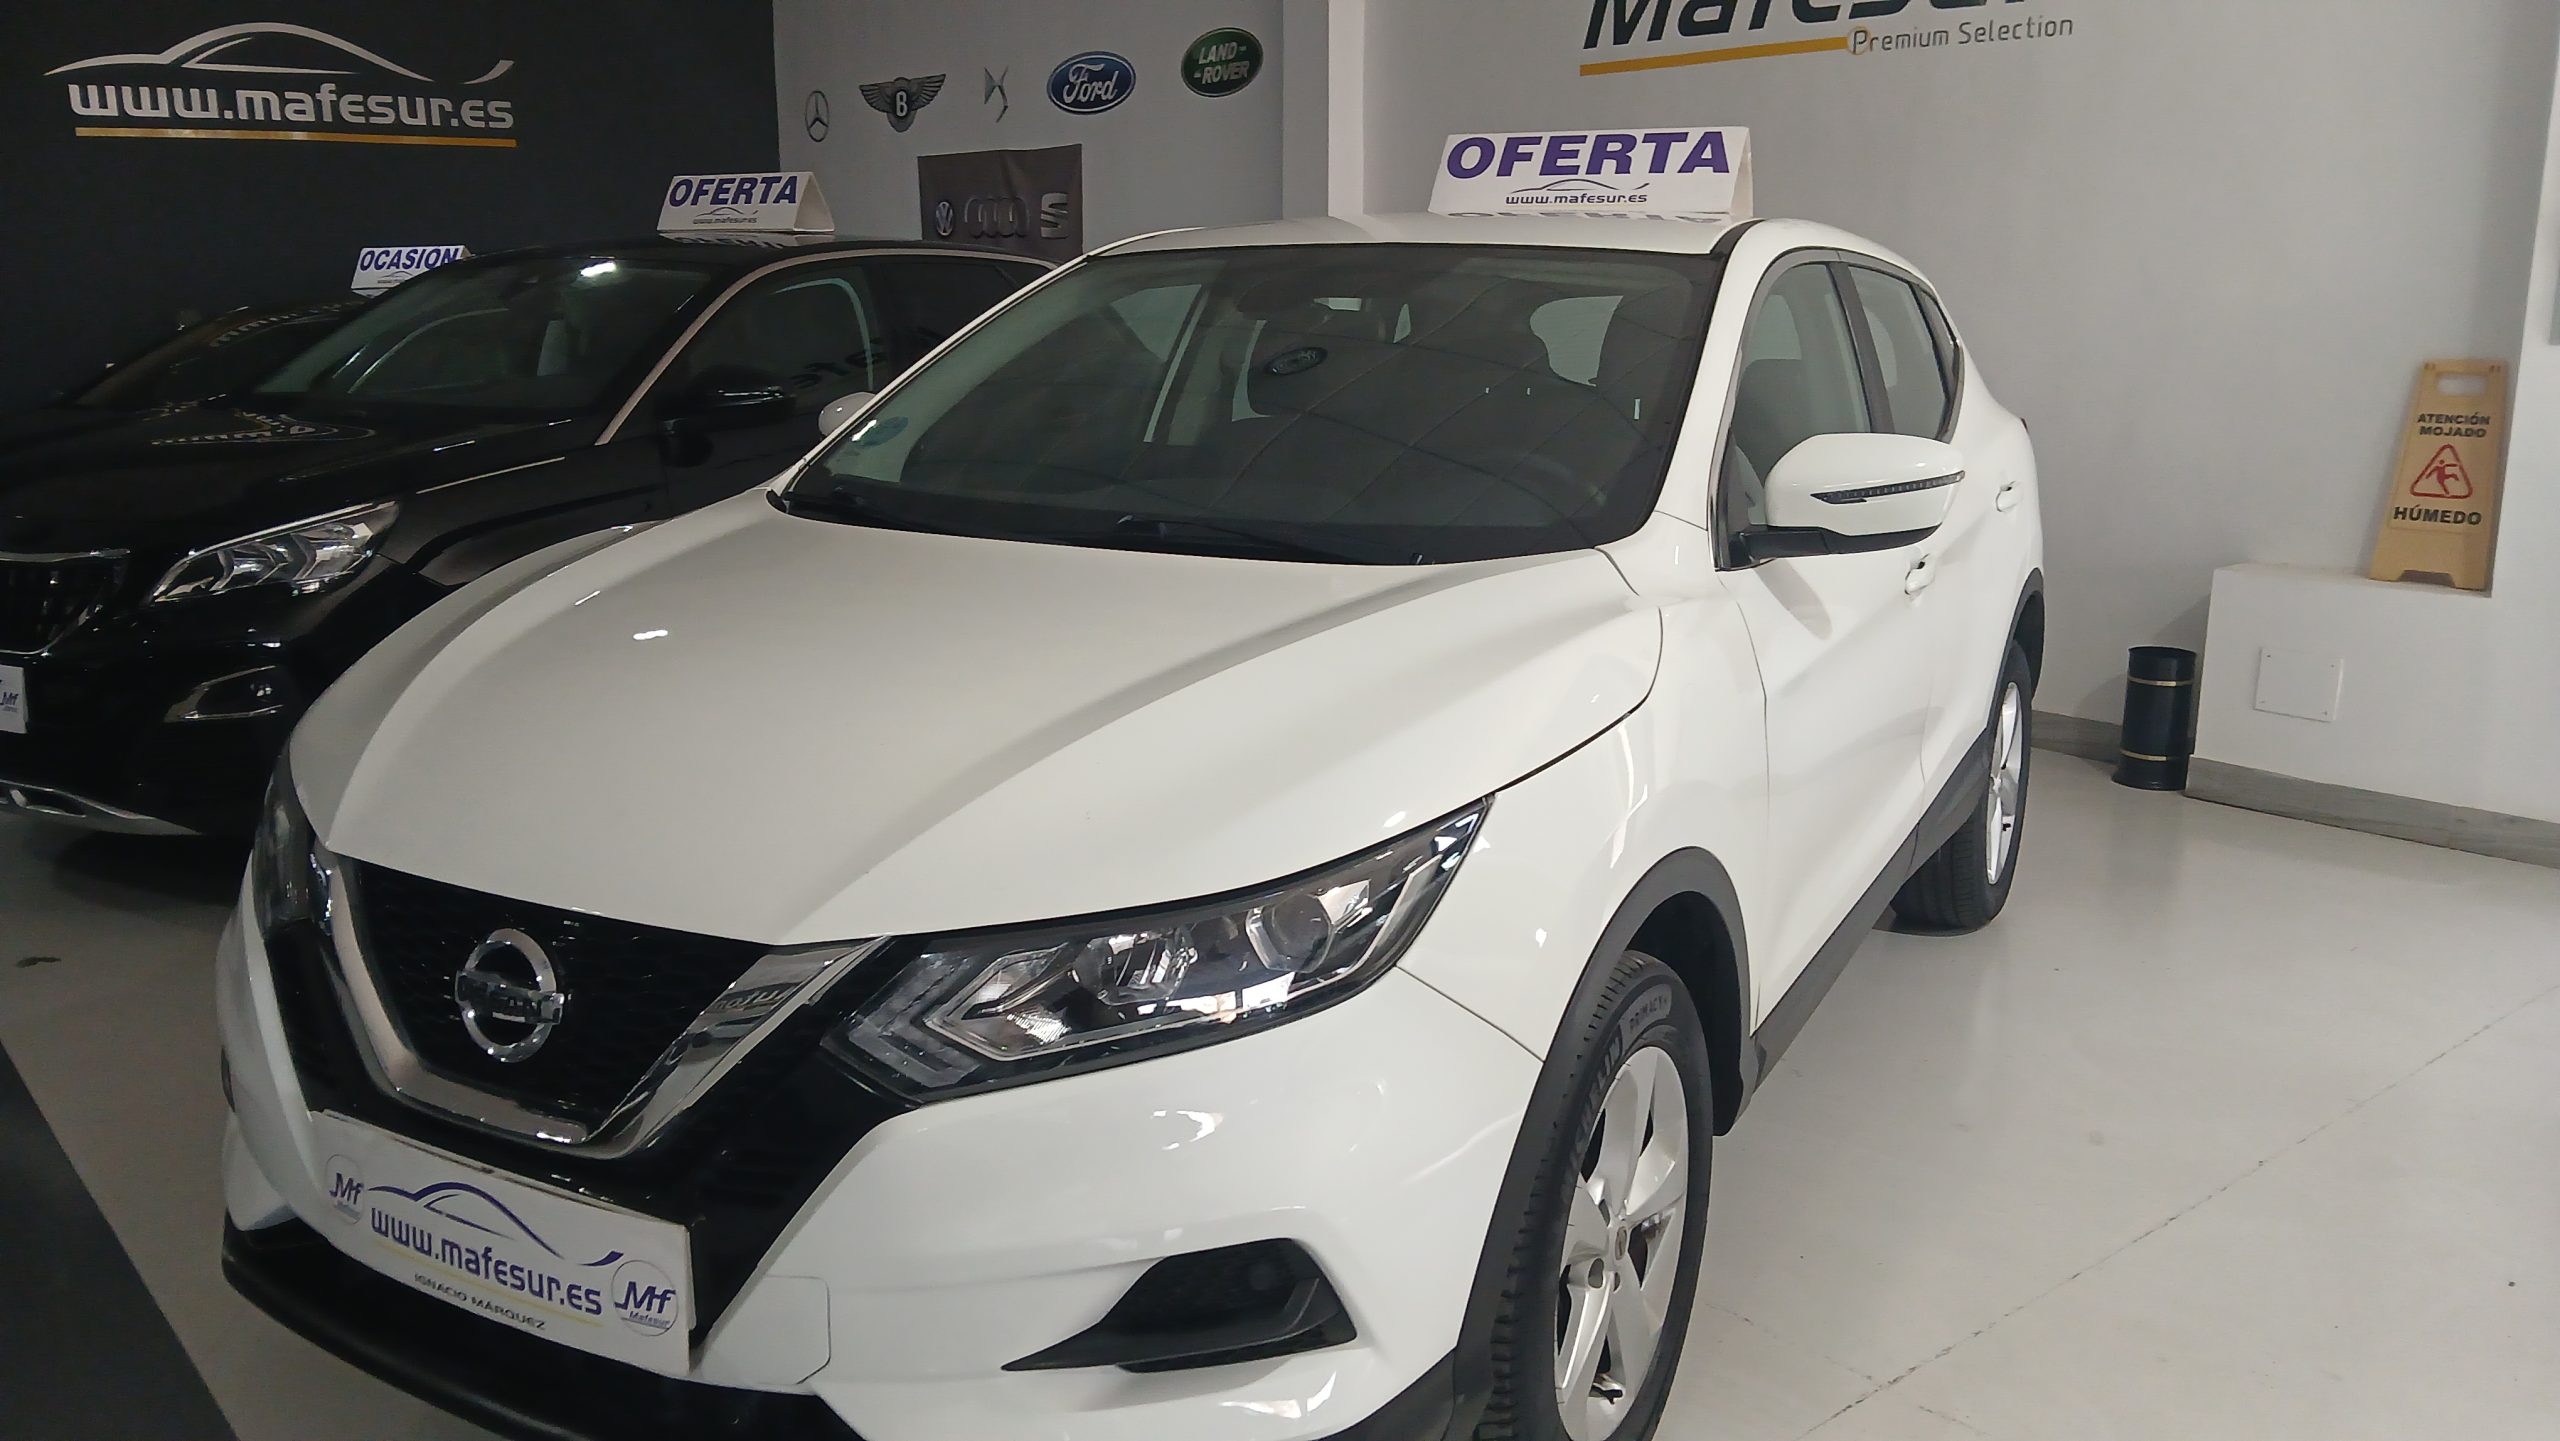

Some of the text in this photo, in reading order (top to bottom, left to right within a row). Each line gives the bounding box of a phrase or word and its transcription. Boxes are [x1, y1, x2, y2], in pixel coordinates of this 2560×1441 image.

[1853, 26, 1949, 54] Premium
[1957, 15, 2074, 45] Selection
[1199, 41, 1237, 64] LAND
[1062, 63, 1119, 104] Ford
[1202, 60, 1250, 84] ROVER
[68, 82, 514, 129] www.mafesur.es
[1447, 131, 1729, 179] OFERTA
[669, 175, 797, 207] OFERTA
[1506, 192, 1647, 205] www.mafesur.es
[360, 248, 459, 271] OCASION
[2417, 411, 2491, 426] ATENCIÓN
[2419, 425, 2487, 438] MOJADO
[2393, 503, 2483, 526] HÚMEDO
[371, 1207, 601, 1316] www.mafesur.es
